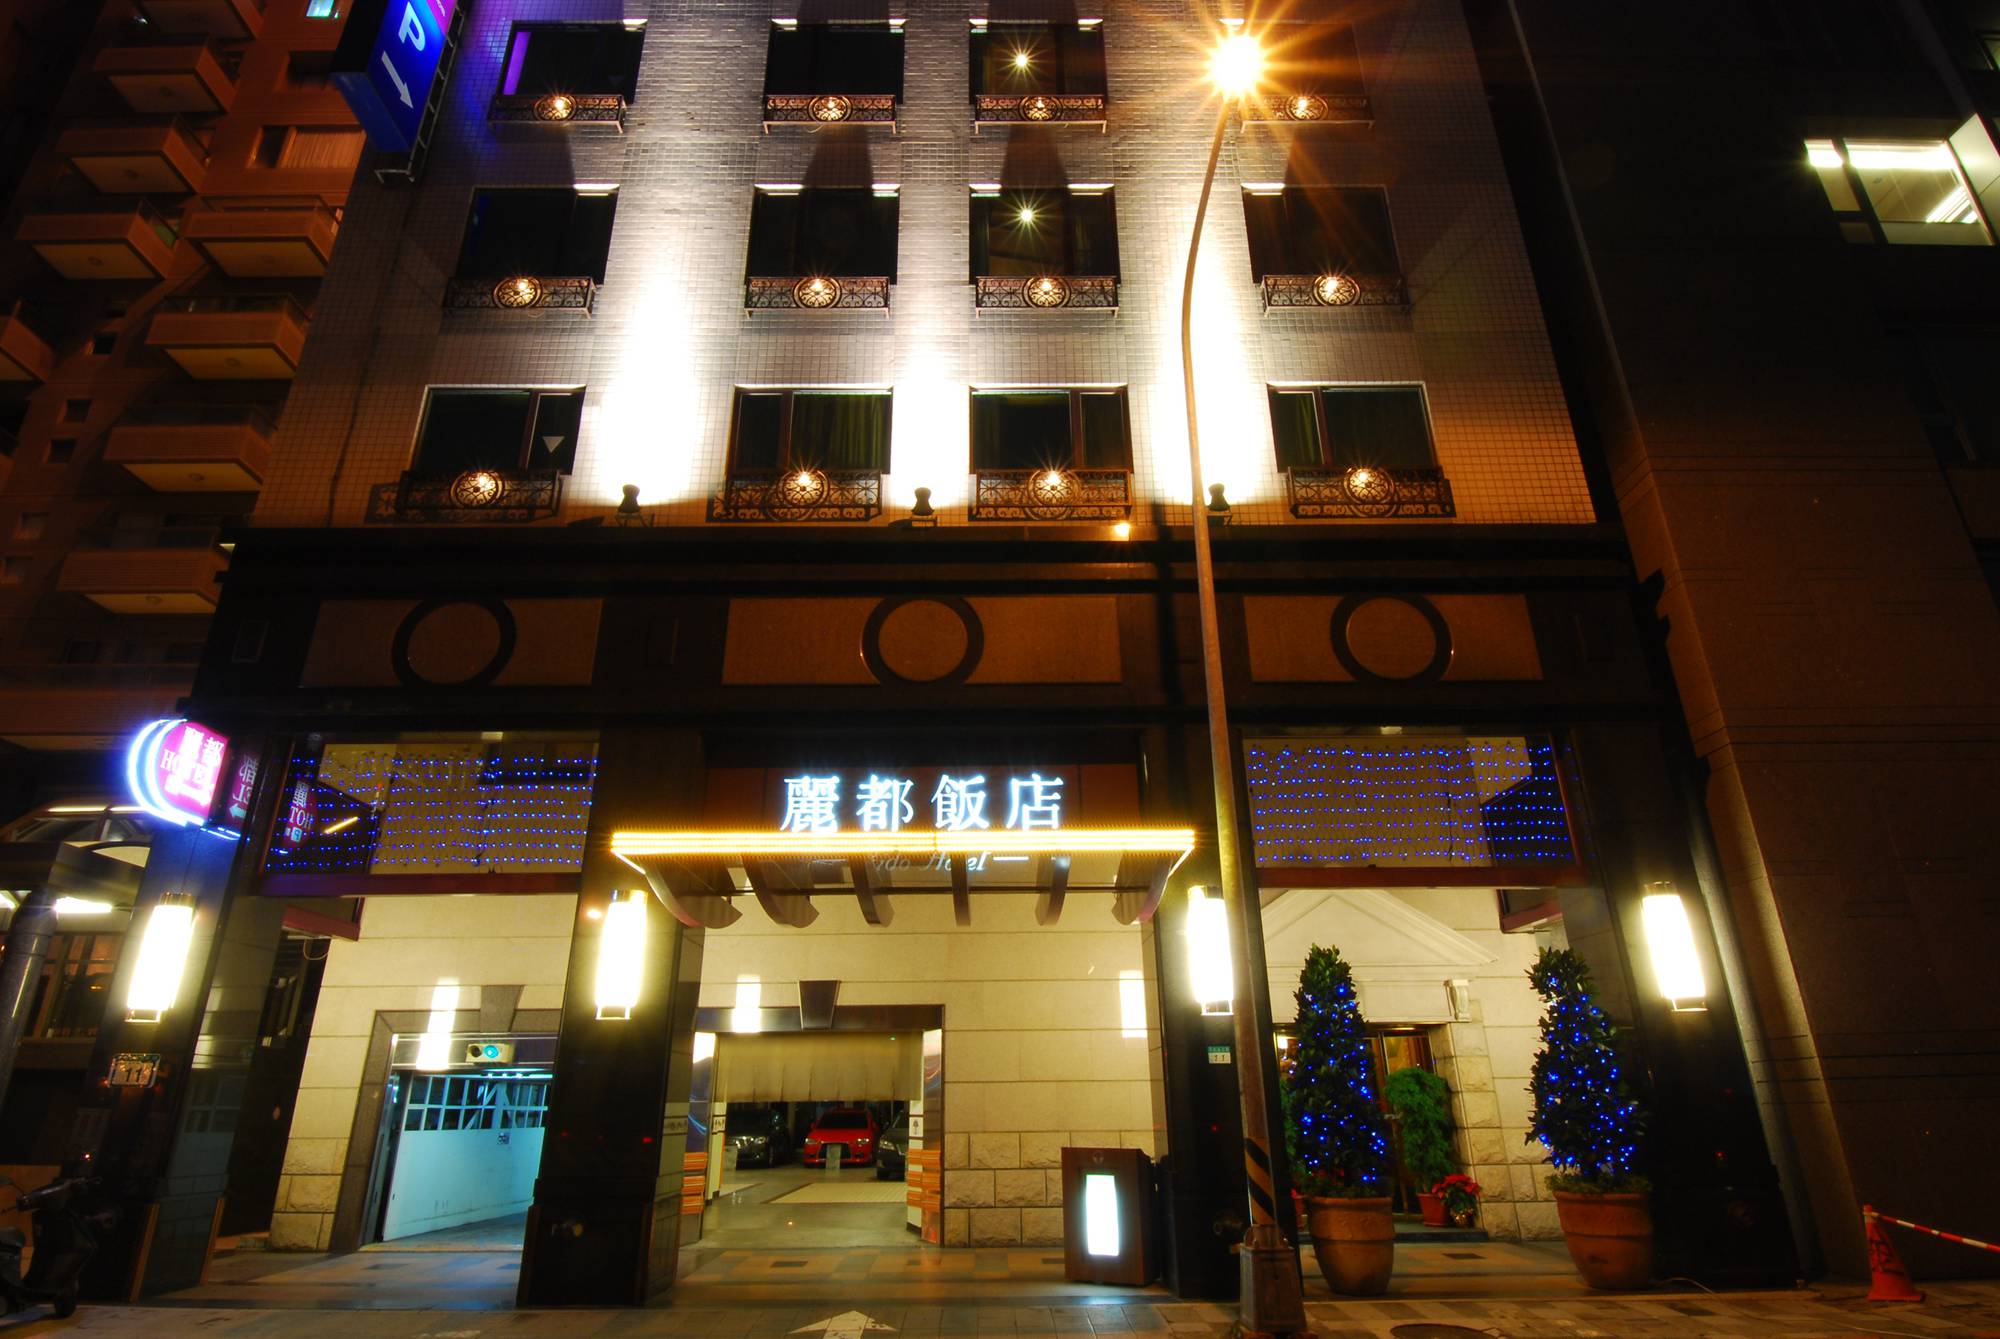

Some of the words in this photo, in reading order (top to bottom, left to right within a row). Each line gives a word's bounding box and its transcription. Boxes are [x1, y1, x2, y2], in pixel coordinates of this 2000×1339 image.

[398, 1, 426, 52] P
[160, 748, 215, 790] HOTEL
[780, 774, 1064, 832] 麗都飯店
[920, 852, 991, 872] Hoel
